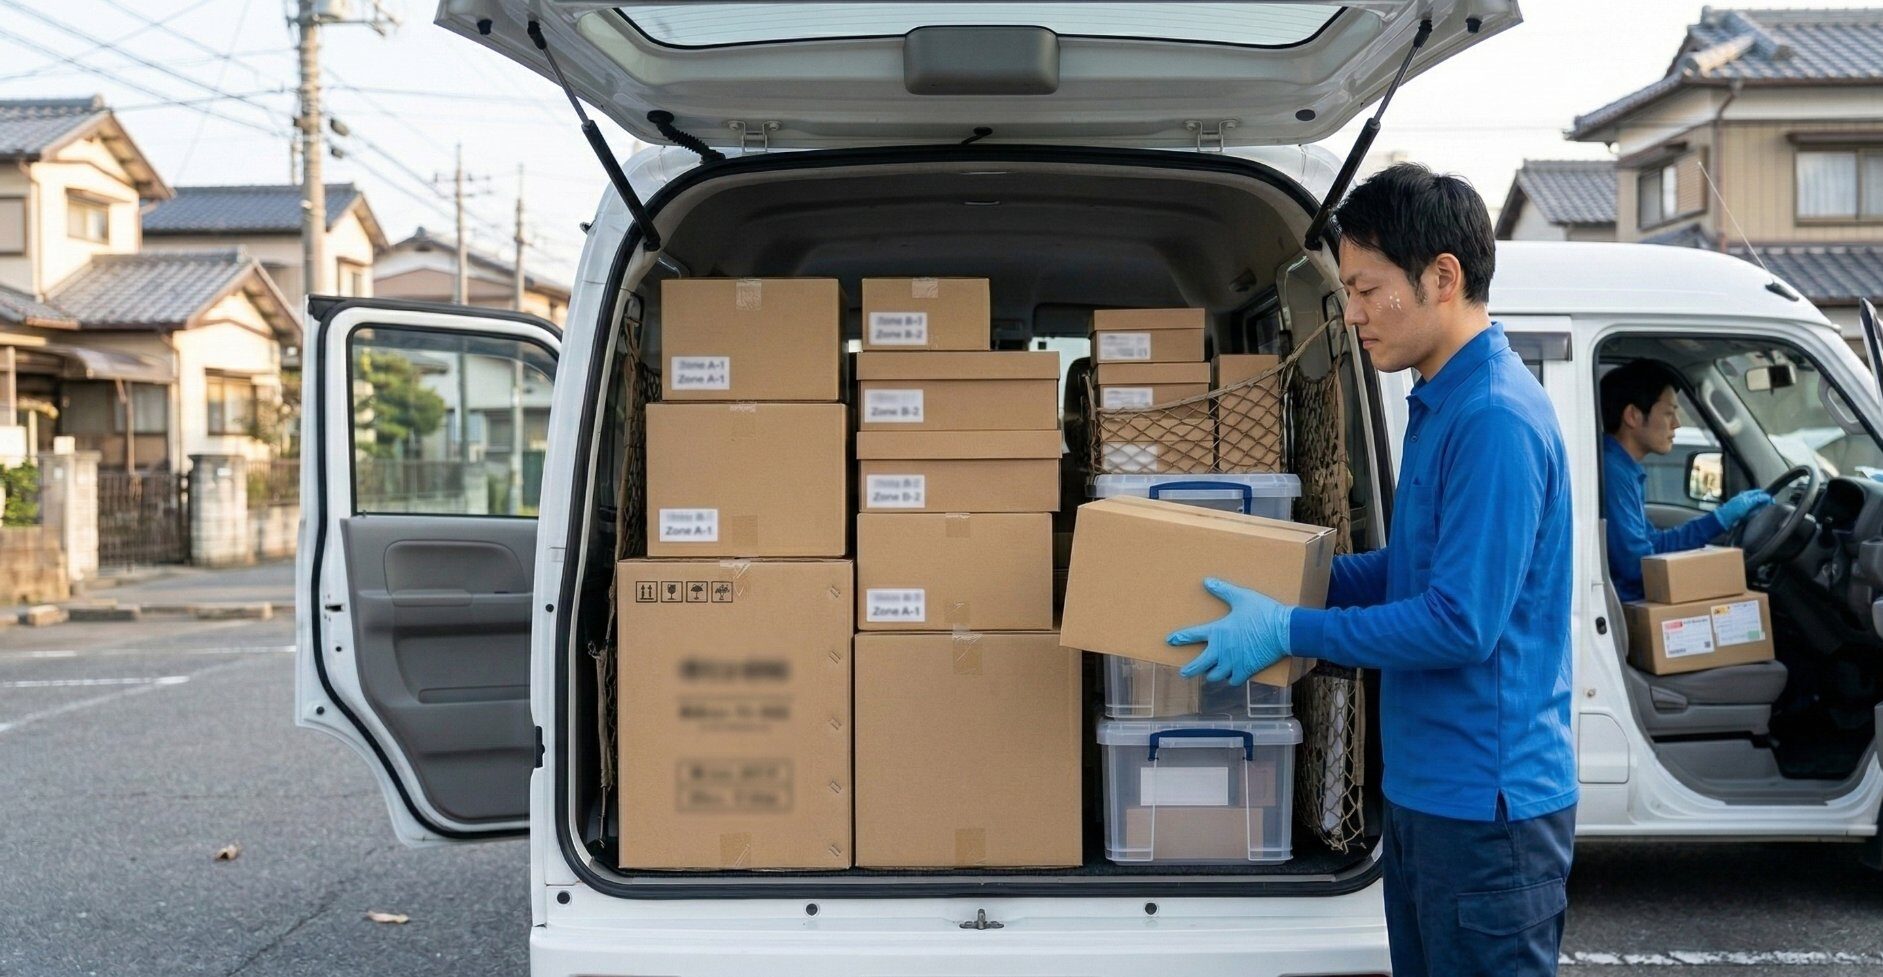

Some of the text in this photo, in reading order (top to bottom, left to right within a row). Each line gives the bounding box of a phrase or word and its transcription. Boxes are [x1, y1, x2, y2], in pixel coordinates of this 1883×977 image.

[875, 330, 901, 340] Zone
[678, 374, 724, 384] Zone A-1
[871, 407, 898, 417] Zone
[873, 492, 899, 502] Zone
[665, 526, 712, 536] Zone A-1
[872, 606, 919, 616] Zone A-1
